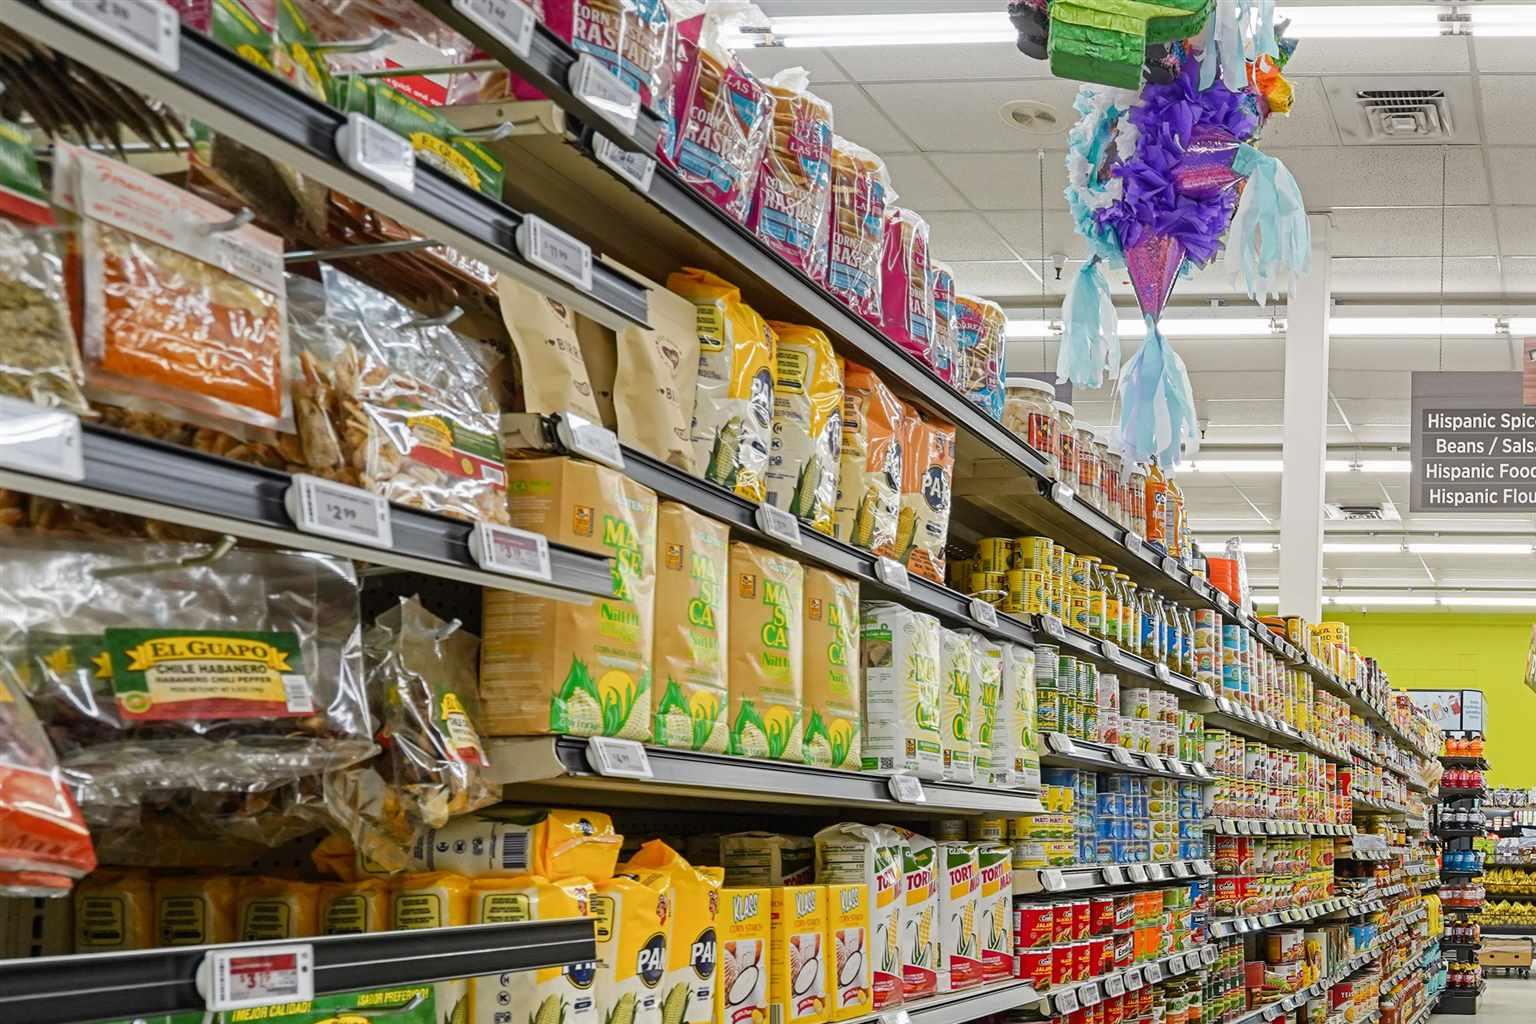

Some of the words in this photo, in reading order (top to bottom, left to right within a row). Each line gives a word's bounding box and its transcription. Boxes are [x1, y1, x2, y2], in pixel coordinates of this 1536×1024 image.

[1427, 413, 1496, 430] Hispanic
[1436, 438, 1484, 454] Beans
[1488, 437, 1498, 455] /
[1426, 463, 1494, 482] Hispanic
[1429, 488, 1497, 507] Hispanic
[688, 600, 715, 629] CA
[761, 623, 789, 650] CA
[151, 643, 184, 657] EL
[186, 641, 269, 659] GUAPO
[156, 663, 194, 674] CHILE
[200, 664, 267, 674] HABANERO
